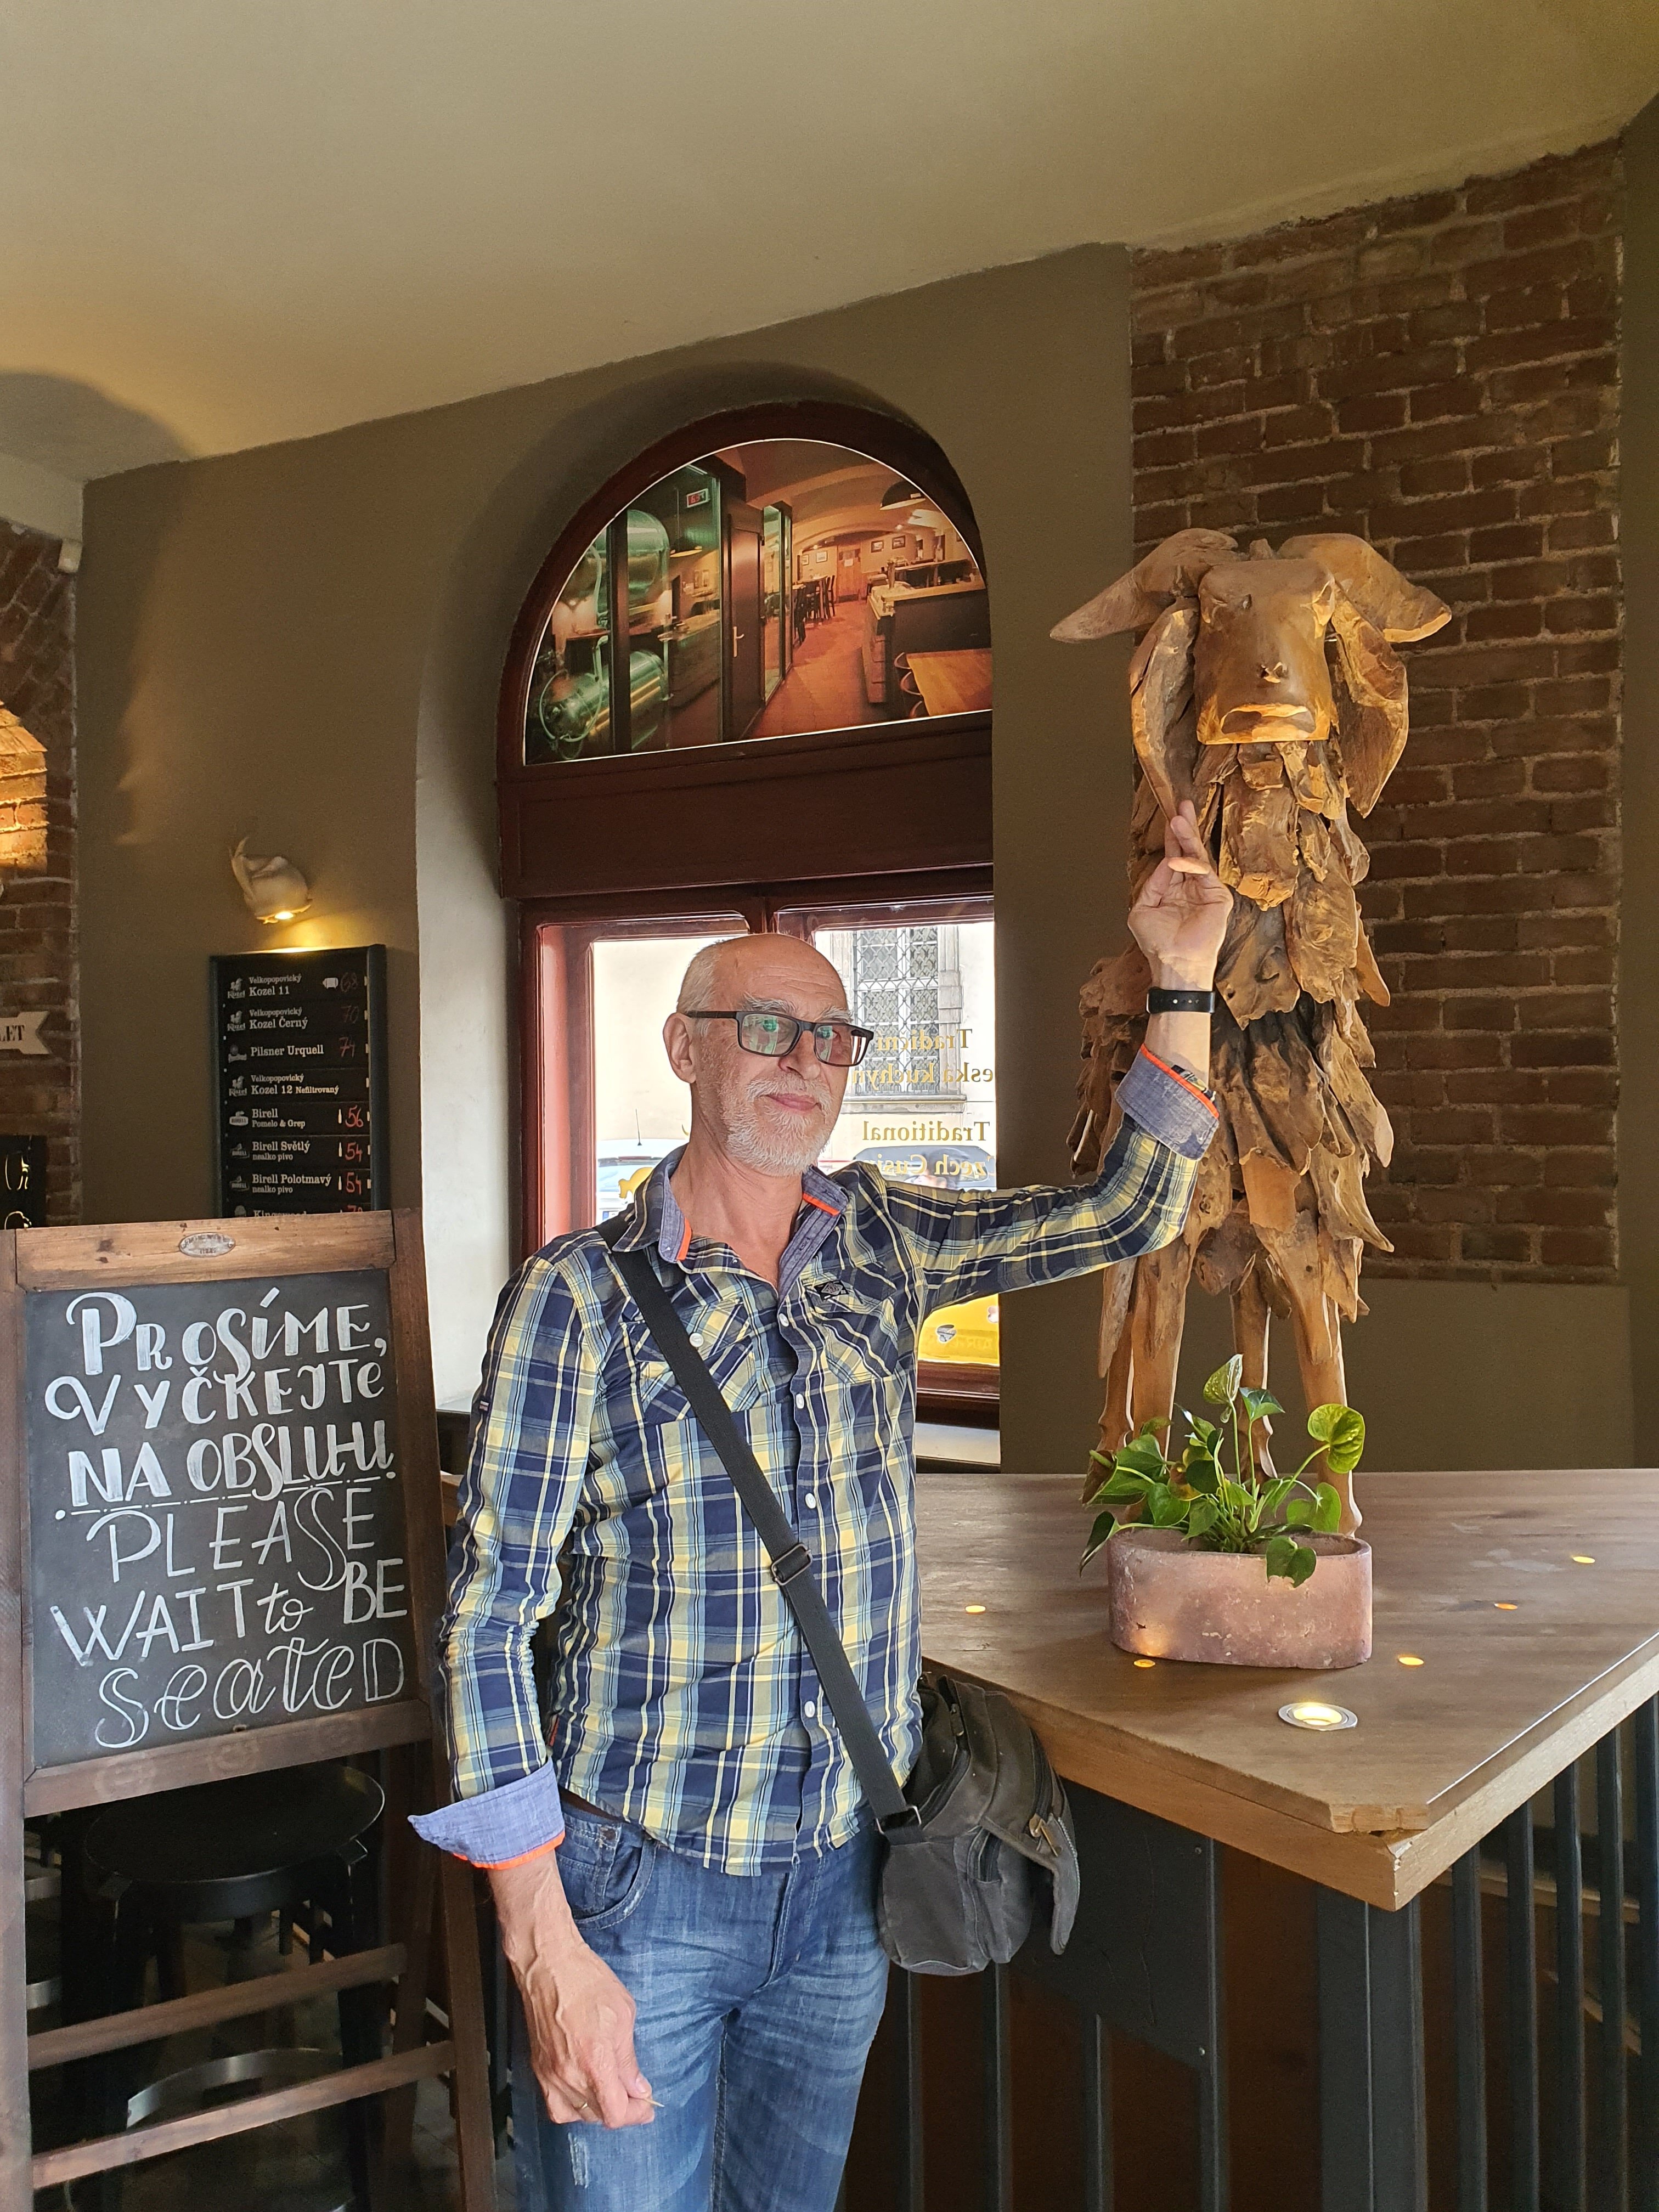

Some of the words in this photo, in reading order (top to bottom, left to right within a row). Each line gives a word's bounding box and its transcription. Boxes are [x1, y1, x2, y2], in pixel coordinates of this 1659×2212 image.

[249, 987, 275, 997] Kozel
[279, 986, 290, 995] 11
[249, 1019, 276, 1029] Kozel
[279, 1015, 308, 1029] Černý
[250, 1046, 284, 1057] Pilsner
[287, 1045, 324, 1057] Urquell
[251, 1085, 278, 1095] Kozel
[281, 1085, 293, 1094] 12
[296, 1085, 340, 1095] Nefiltrovaný
[252, 1108, 278, 1119] Birell
[345, 1105, 364, 1127] 56
[287, 1120, 306, 1129] Grep
[252, 1141, 278, 1152] Birell
[281, 1141, 311, 1154] Světlý
[345, 1142, 363, 1163] 54
[278, 1154, 294, 1163] pivo
[252, 1174, 278, 1184] Birell
[281, 1173, 332, 1187] Polotmavý
[346, 1172, 362, 1195] 54
[278, 1186, 294, 1194] pivo
[67, 1441, 172, 1506] NA
[86, 1487, 375, 1591] PLEASE
[50, 1578, 255, 1667] WAIT
[257, 1582, 314, 1634] to
[343, 1558, 408, 1624] BE
